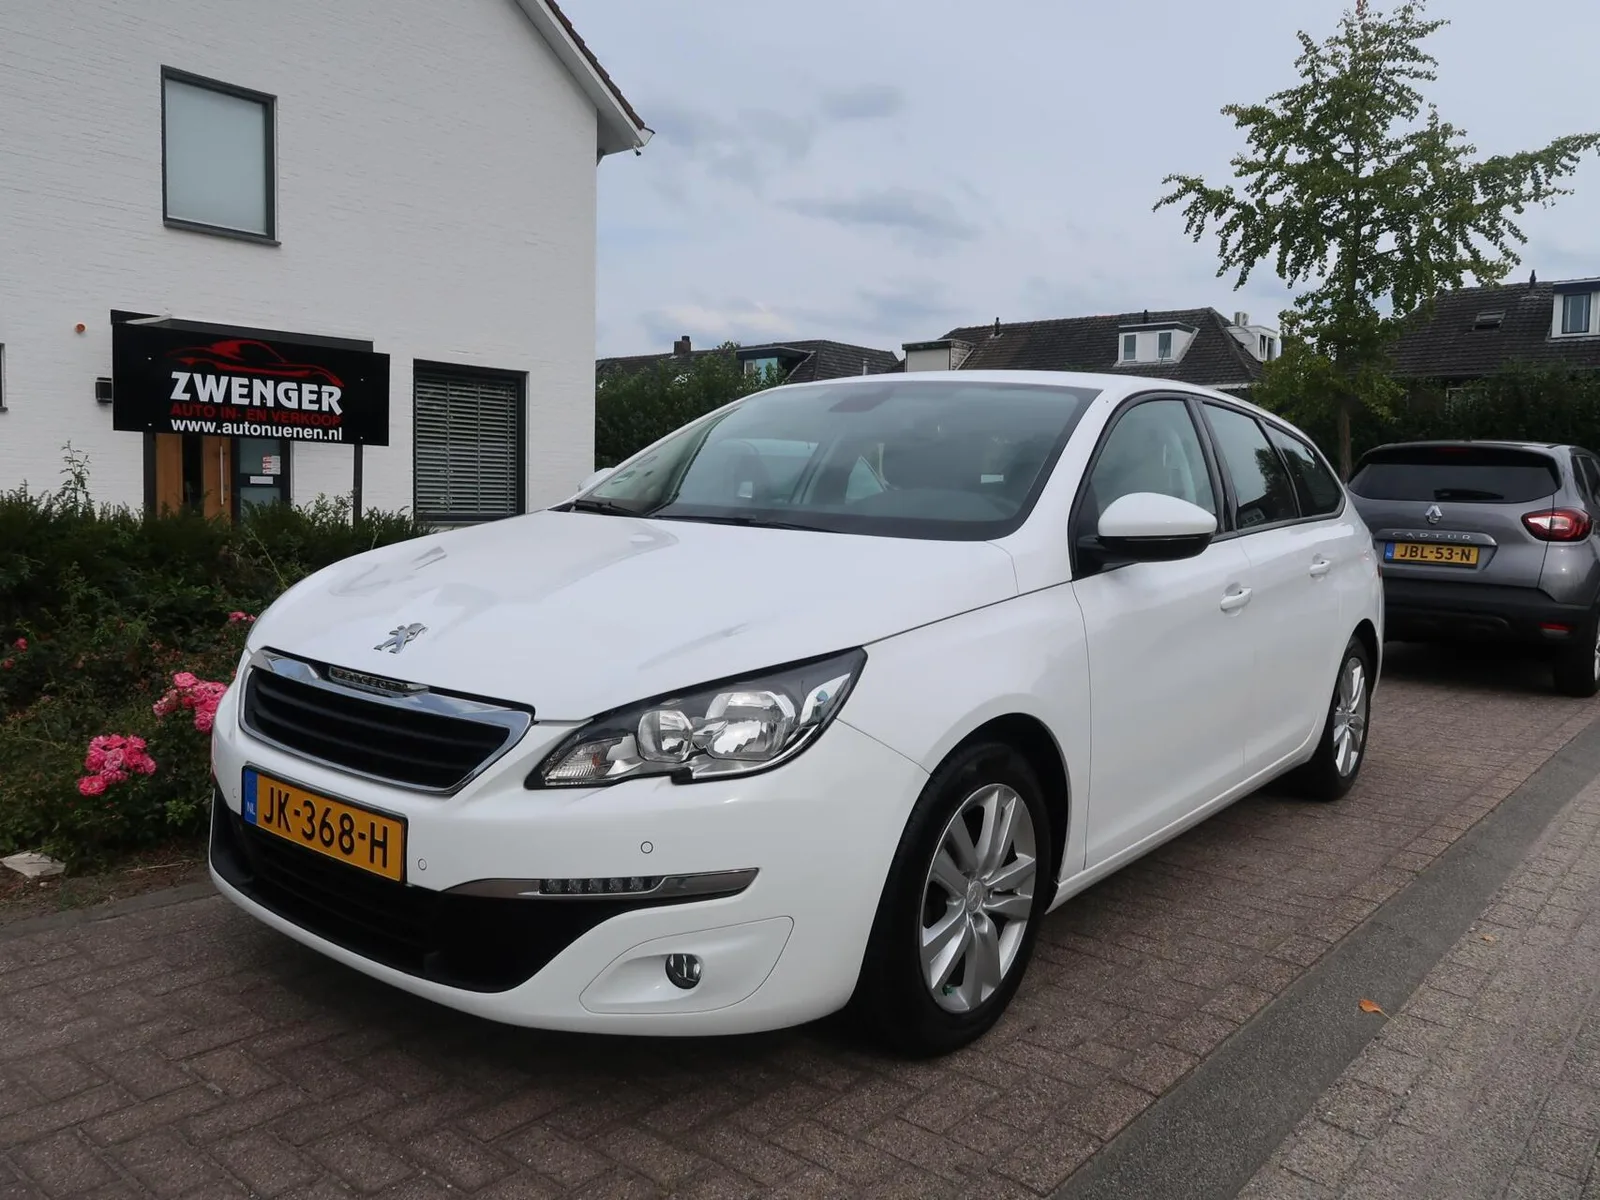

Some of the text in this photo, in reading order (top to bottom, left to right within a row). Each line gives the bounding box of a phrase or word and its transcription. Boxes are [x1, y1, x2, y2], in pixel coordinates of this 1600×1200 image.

[170, 371, 343, 416] ZWENGER
[170, 403, 343, 427] AUTO IN- EN VERKOOP
[170, 419, 343, 441] www.autonuenen.nl
[1400, 545, 1472, 562] JBL-53-N
[246, 801, 256, 816] NL
[263, 786, 389, 869] JK-368-H
